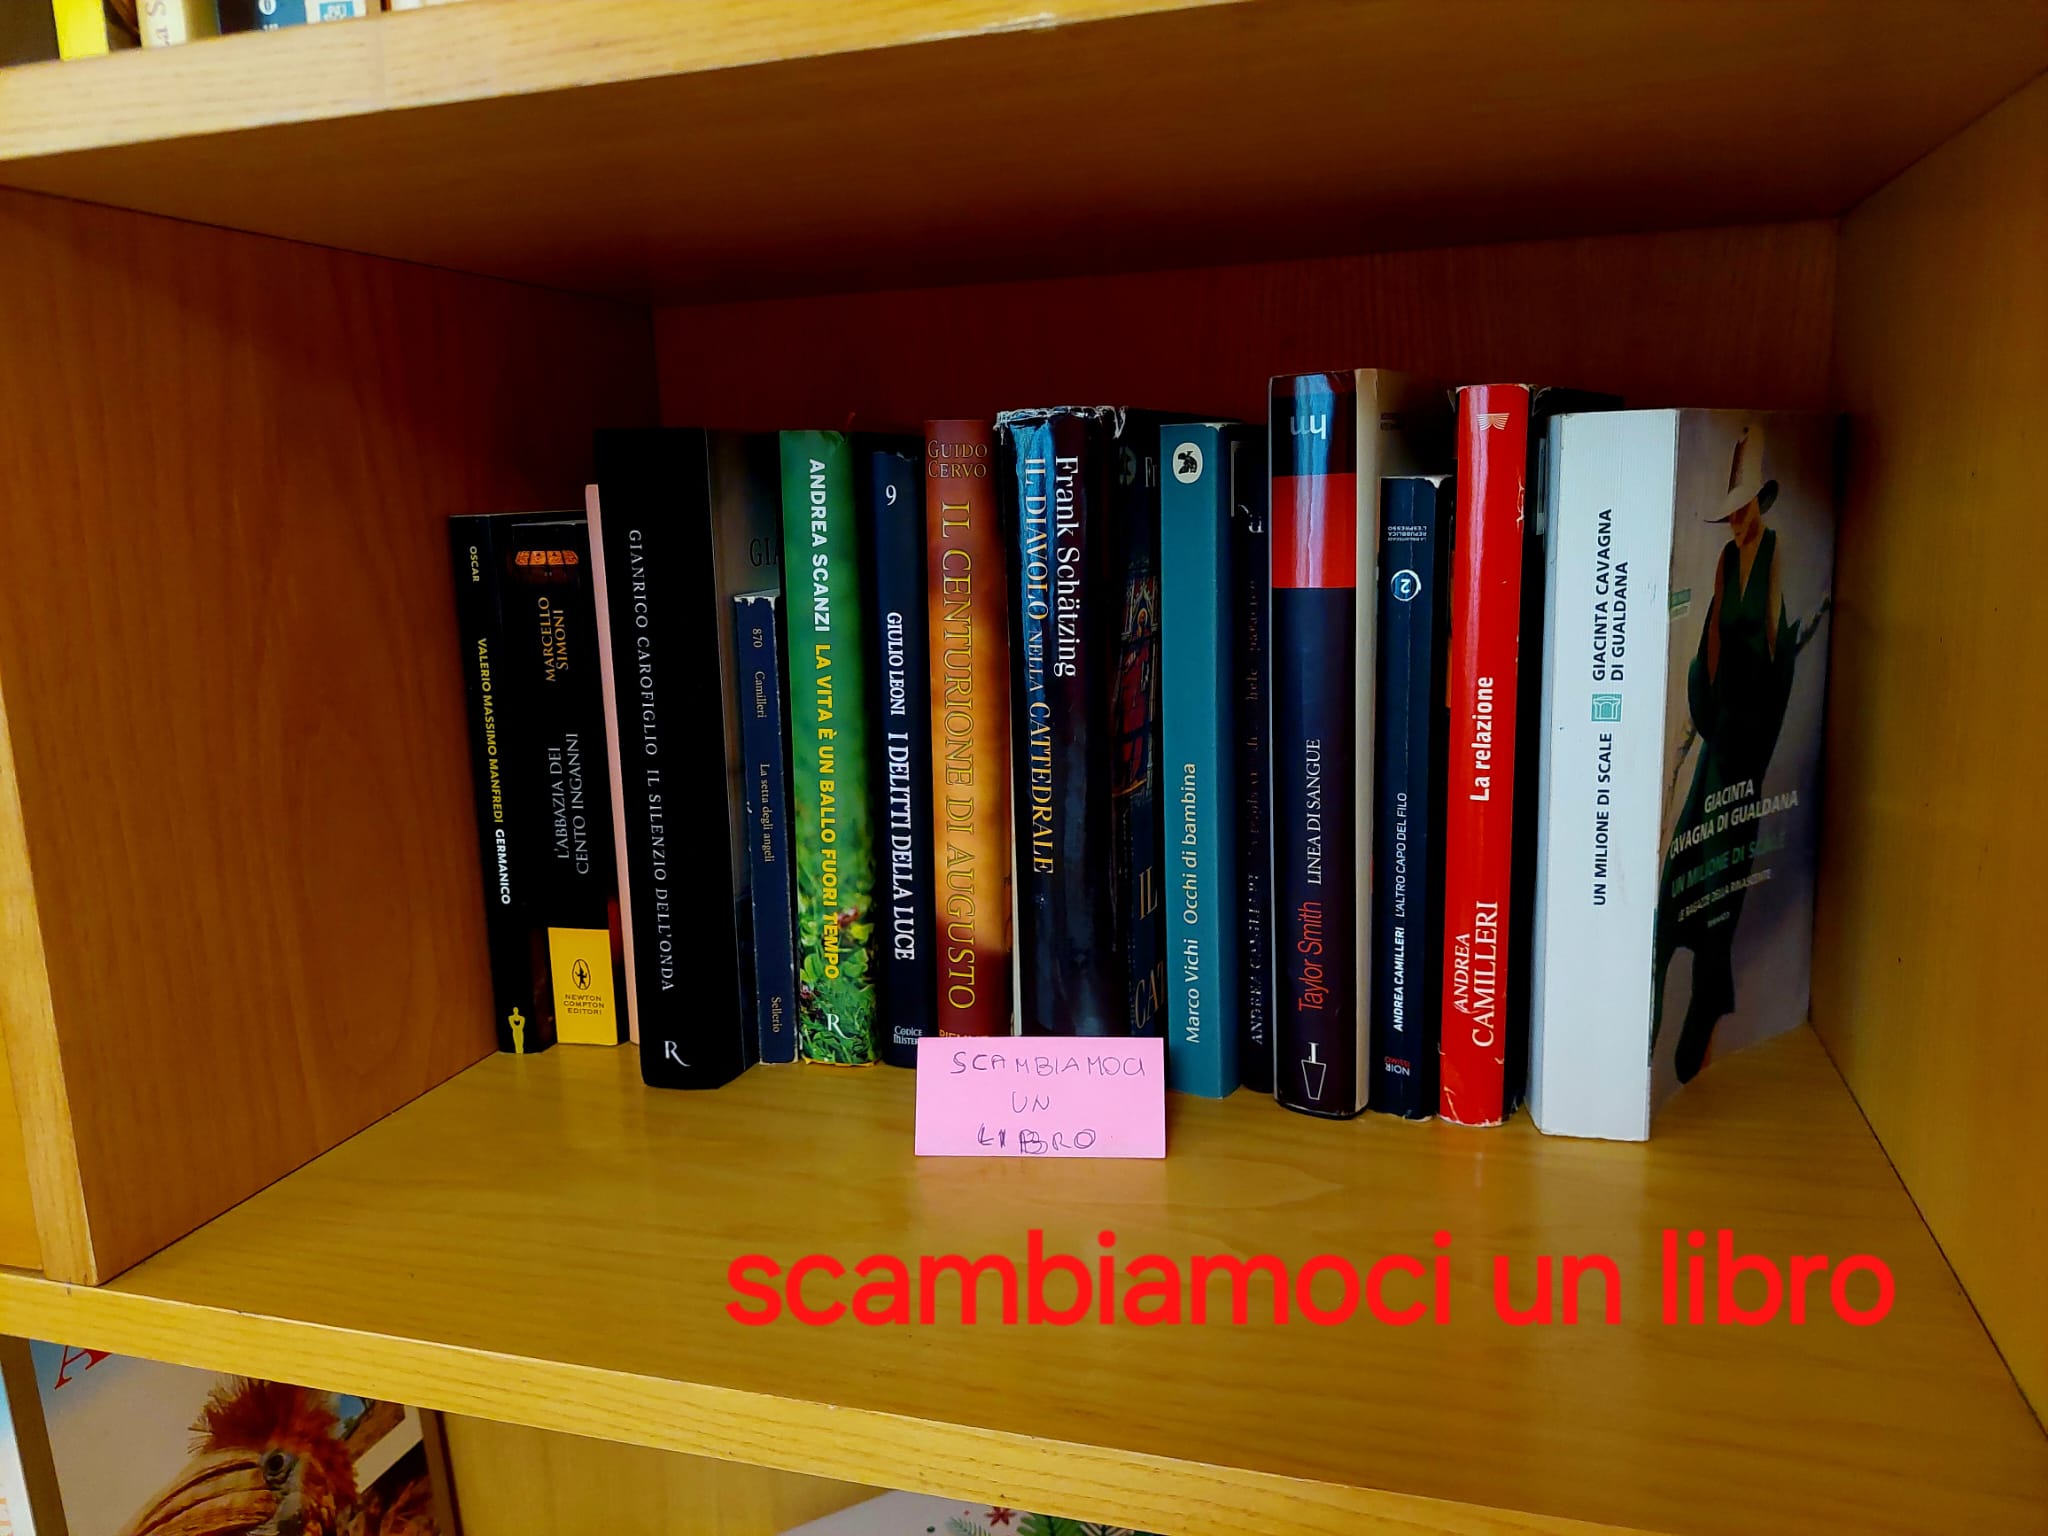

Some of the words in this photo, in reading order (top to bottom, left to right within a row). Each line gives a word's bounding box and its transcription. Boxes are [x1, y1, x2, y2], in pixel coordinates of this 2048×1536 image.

[927, 440, 988, 459] GUIDO
[927, 460, 987, 478] CERVO
[1025, 457, 1047, 485] IL
[809, 458, 828, 547] ANDREA
[885, 484, 898, 506] 9
[941, 500, 971, 539] IL
[1055, 456, 1080, 537] Frank
[468, 545, 481, 583] OSCAR
[1025, 496, 1049, 621] DIAVOLO
[1596, 508, 1613, 596] CAVAGNA
[628, 529, 649, 629] GIANRICO
[811, 554, 831, 632] SCANZI
[1400, 578, 1411, 594] 2
[1053, 547, 1081, 677] Schätzing
[1611, 561, 1629, 659] GUALDANA
[537, 596, 557, 683] MARCELLO
[552, 609, 569, 671] SIMONI
[752, 627, 763, 648] 870
[815, 644, 832, 670] LA
[887, 611, 905, 667] GIULIO
[1027, 629, 1044, 692] NELLA
[1592, 600, 1609, 681] GIACINTA
[477, 637, 493, 693] VALERIO
[942, 549, 975, 786] CENTURIONE
[1611, 664, 1625, 681] DI
[637, 636, 658, 756] CAROFIGLIO
[755, 670, 768, 719] Camilleri
[816, 675, 833, 722] VITA
[888, 670, 906, 716] LEONI
[482, 694, 498, 757] MASSIMO
[887, 732, 909, 741] I
[1470, 676, 1494, 770] relazione
[547, 747, 563, 775] DEI
[565, 733, 585, 809] INGANNI
[646, 769, 661, 788] IL
[760, 763, 770, 777] La
[818, 745, 834, 774] UN
[1305, 738, 1321, 811] SANGUE
[1598, 732, 1613, 784] SCALE
[488, 758, 504, 823] MANFREDI
[760, 779, 770, 804] setta
[819, 779, 837, 843] BALLO
[888, 745, 912, 830] DELITTI
[1028, 702, 1055, 874] CATTEDRALE
[1180, 762, 1198, 846] bambina
[1396, 792, 1408, 818] FILO
[1469, 776, 1491, 802] La
[1597, 788, 1611, 806] DI
[1704, 778, 1755, 814] GIACINTA
[551, 780, 570, 860] L'ABBAZIA
[648, 793, 667, 881] SILENZIO
[761, 806, 774, 831] degli
[945, 797, 975, 835] DI
[1306, 813, 1321, 833] DI
[1396, 819, 1408, 841] DEL
[1669, 819, 1715, 860] CAVAGNA
[1716, 814, 1730, 833] DI
[1730, 789, 1800, 827] GUALDANA
[495, 828, 512, 905] GERMANICO
[572, 815, 589, 875] CENTO
[762, 832, 776, 863] angeli
[890, 834, 914, 900] DELLA
[1181, 849, 1198, 869] di
[1307, 836, 1322, 886] LINEA
[1395, 841, 1407, 874] CAPO
[1594, 810, 1610, 878] MILIONE
[820, 848, 838, 907] FUORI
[1182, 872, 1198, 926] Occhi
[1395, 875, 1406, 918] L'ALTRO
[1593, 883, 1607, 906] UN
[655, 887, 675, 992] DELL'ONDA
[822, 911, 841, 980] TEMPO
[892, 906, 915, 961] LUCE
[946, 843, 977, 1010] AUGUSTO
[1297, 900, 1323, 956] Smith
[1183, 937, 1199, 984] Vichi
[1394, 926, 1406, 985] CAMILLERI
[1453, 932, 1472, 1013] ANDREA
[1472, 900, 1499, 1048] CAMILLERI
[563, 1000, 605, 1009] COMPTON
[564, 993, 603, 1002] NEWTON
[567, 1007, 603, 1015] EDITORI
[1297, 958, 1330, 1013] Taylor
[1393, 985, 1405, 1033] ANDREA
[771, 996, 783, 1033] Sellerio
[827, 1013, 853, 1040] R
[1185, 986, 1201, 1044] Marco
[664, 1040, 692, 1068] R
[1384, 1062, 1411, 1077] NOIR
[1011, 1090, 1051, 1114] UN
[977, 1121, 1097, 1155] LIBRO
